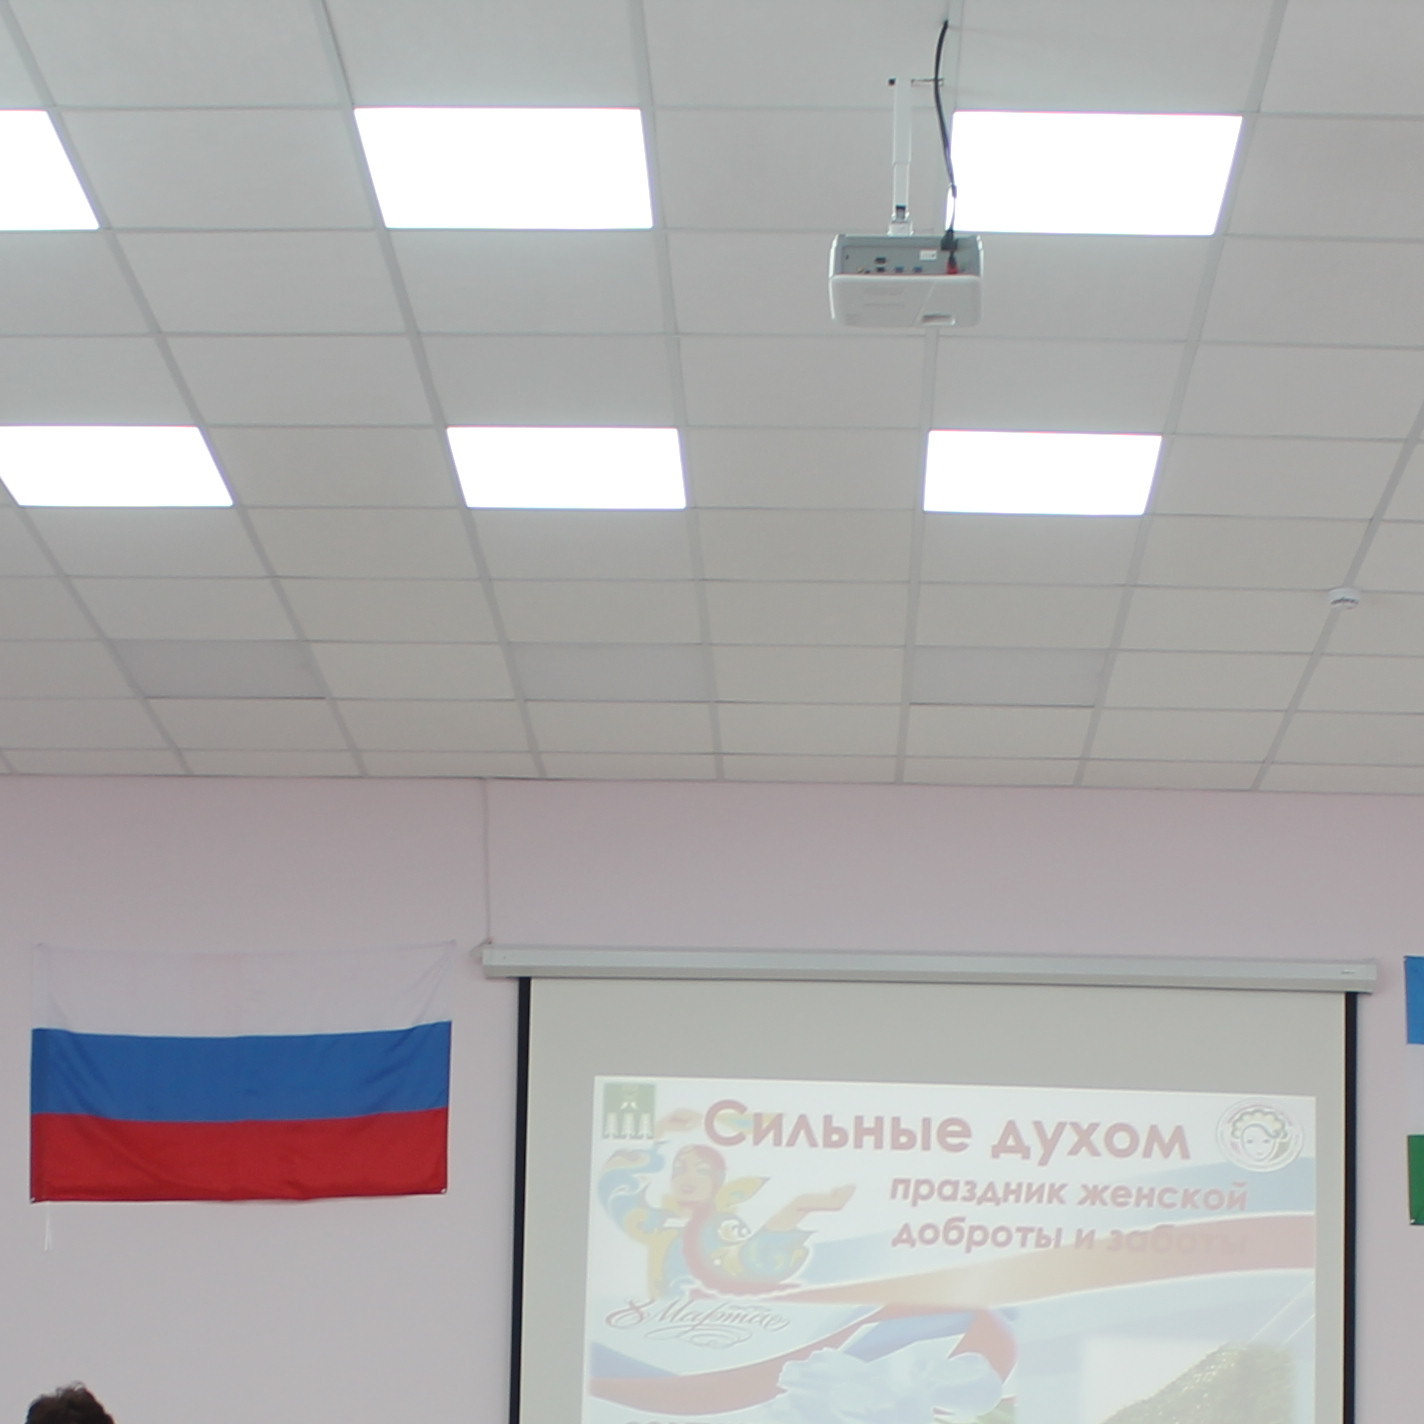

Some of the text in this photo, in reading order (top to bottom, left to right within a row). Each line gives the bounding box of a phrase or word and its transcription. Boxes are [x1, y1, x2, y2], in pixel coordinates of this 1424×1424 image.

[704, 1098, 1191, 1168] Сильные духом
[890, 1177, 1249, 1211] праздник женской
[891, 1216, 1063, 1254] доброты
[1074, 1227, 1096, 1250] и
